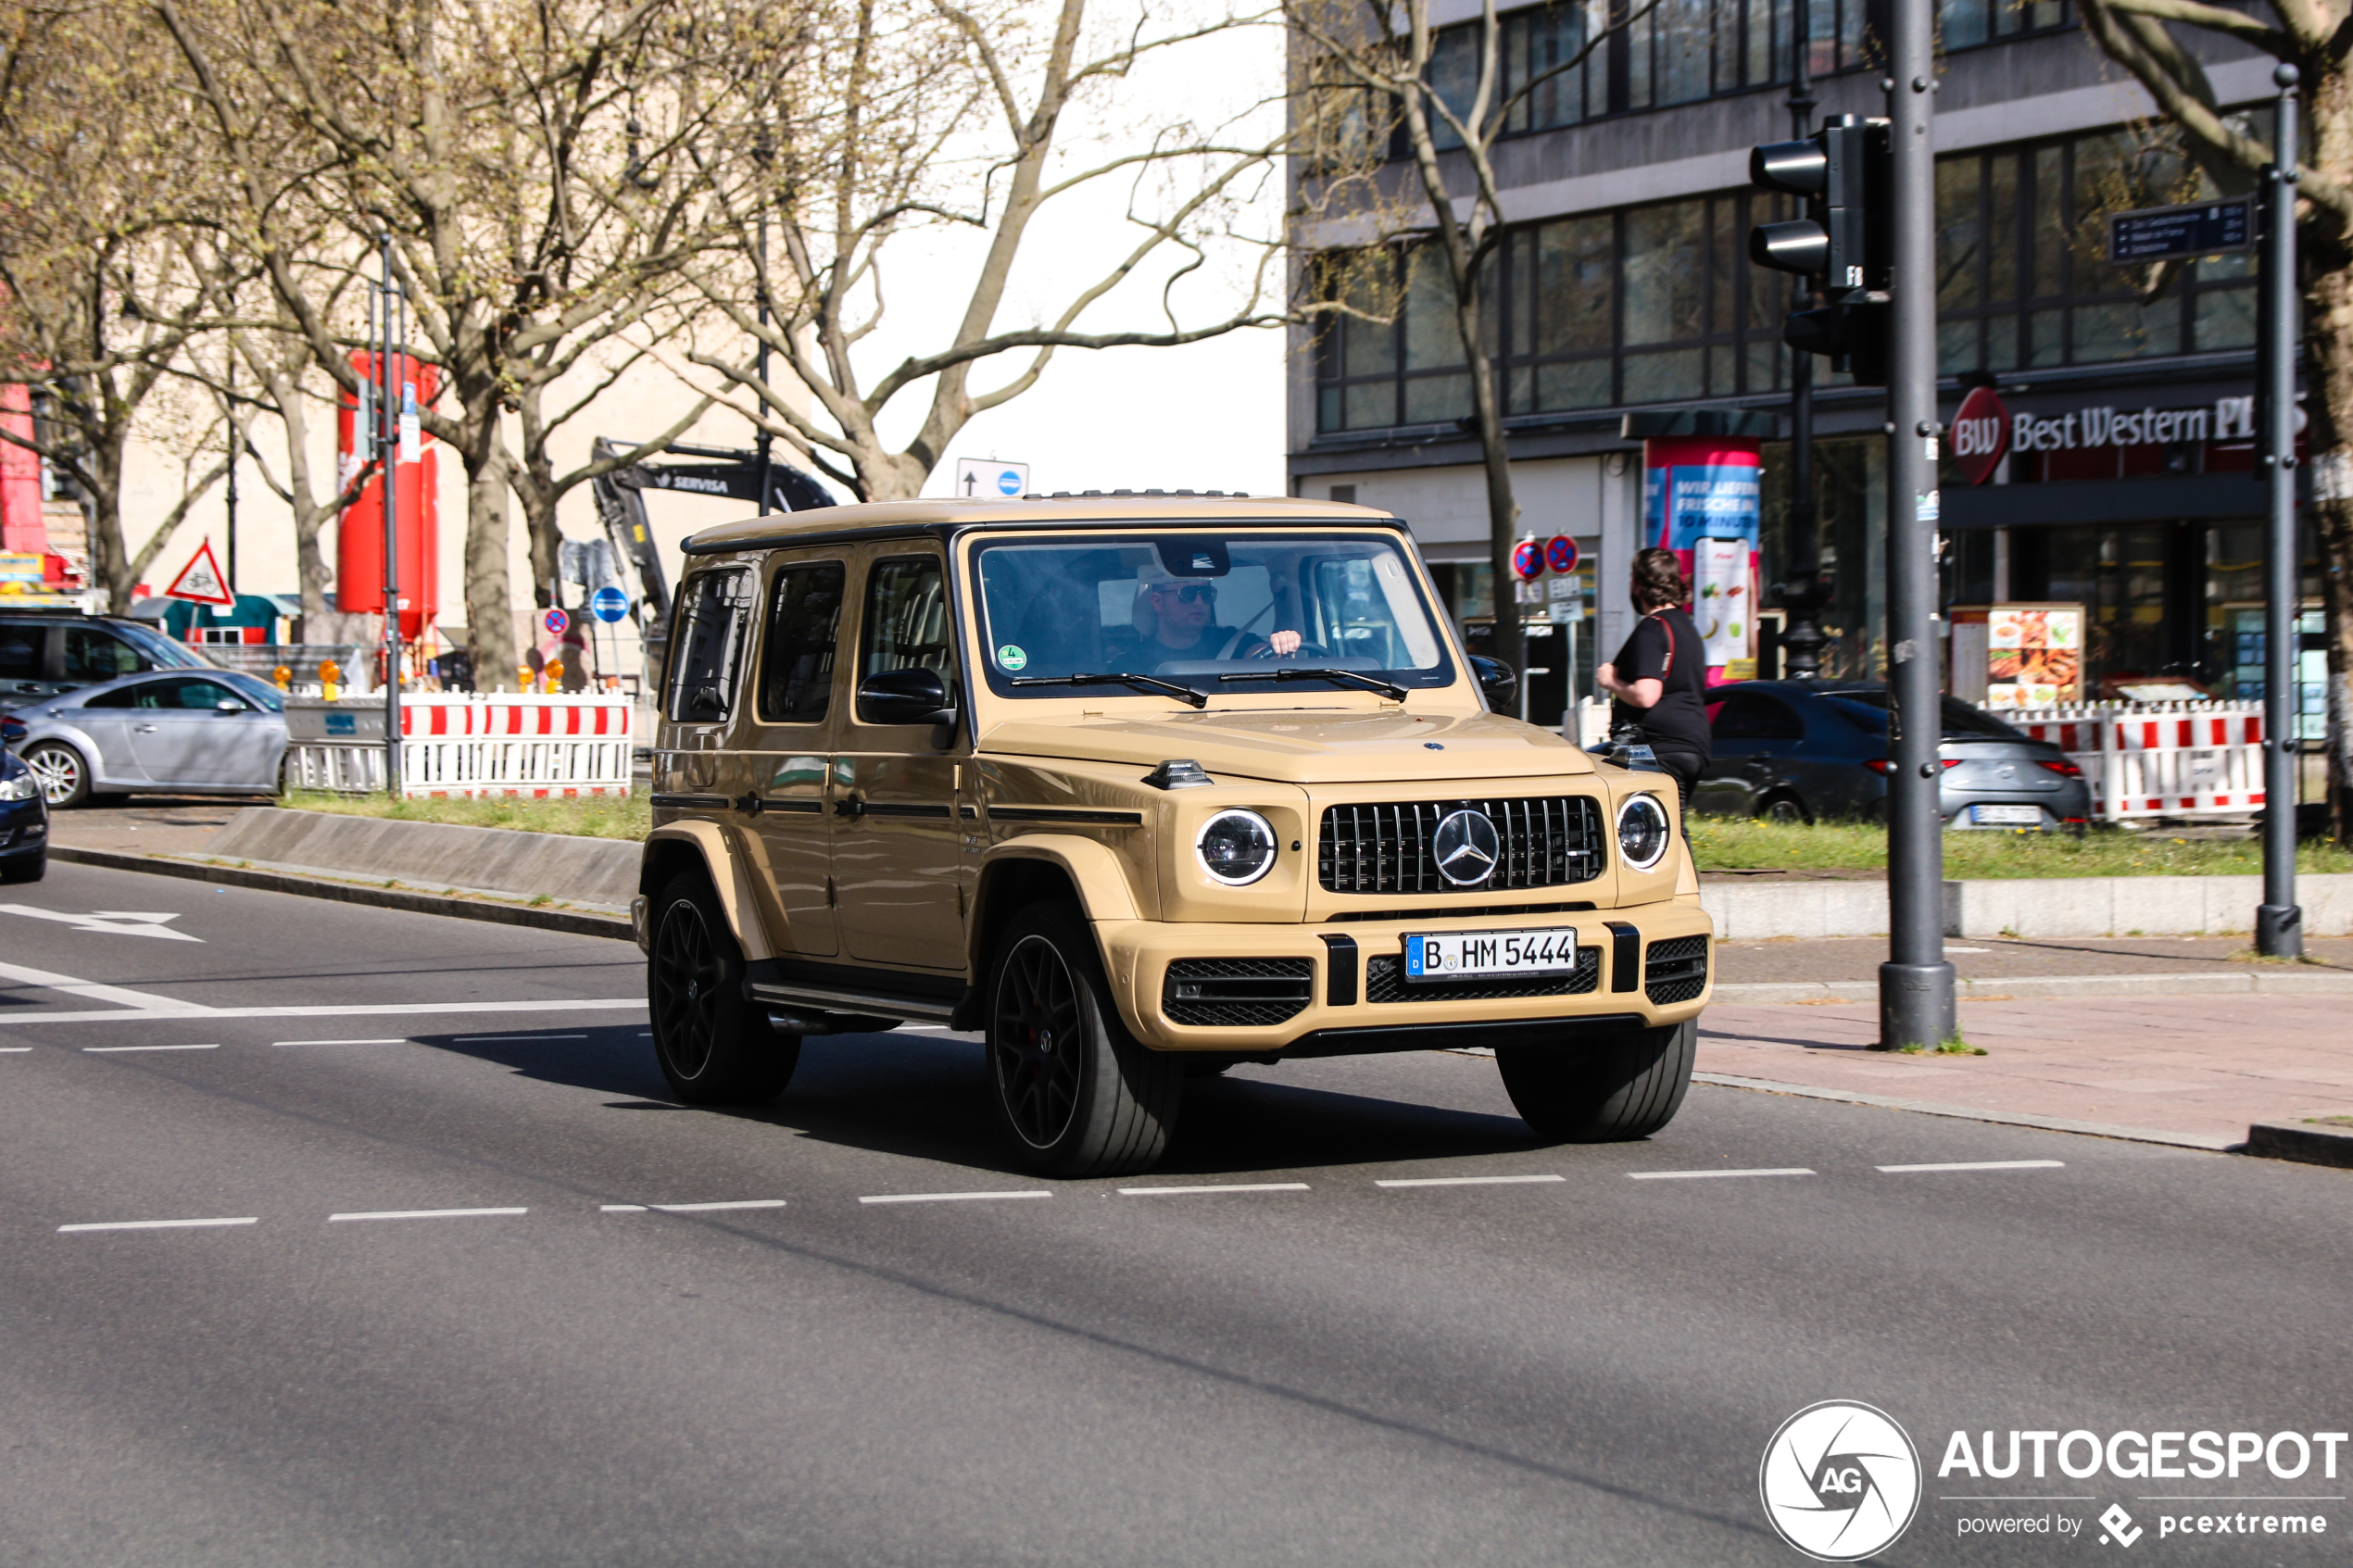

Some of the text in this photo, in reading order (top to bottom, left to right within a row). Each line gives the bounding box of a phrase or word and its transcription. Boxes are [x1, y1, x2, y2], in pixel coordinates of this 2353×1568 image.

[1846, 265, 1864, 287] F8
[2012, 391, 2308, 452] Best Western PLS
[1956, 416, 2000, 457] BW
[673, 475, 729, 494] SERVISA
[1677, 481, 1712, 495] WIR
[1676, 497, 1742, 512] FRISCHE
[1678, 515, 1696, 528] 10
[1008, 647, 1016, 659] 4
[966, 835, 977, 844] V8
[1426, 935, 1571, 970] B HM 5444
[1413, 960, 1419, 969] D
